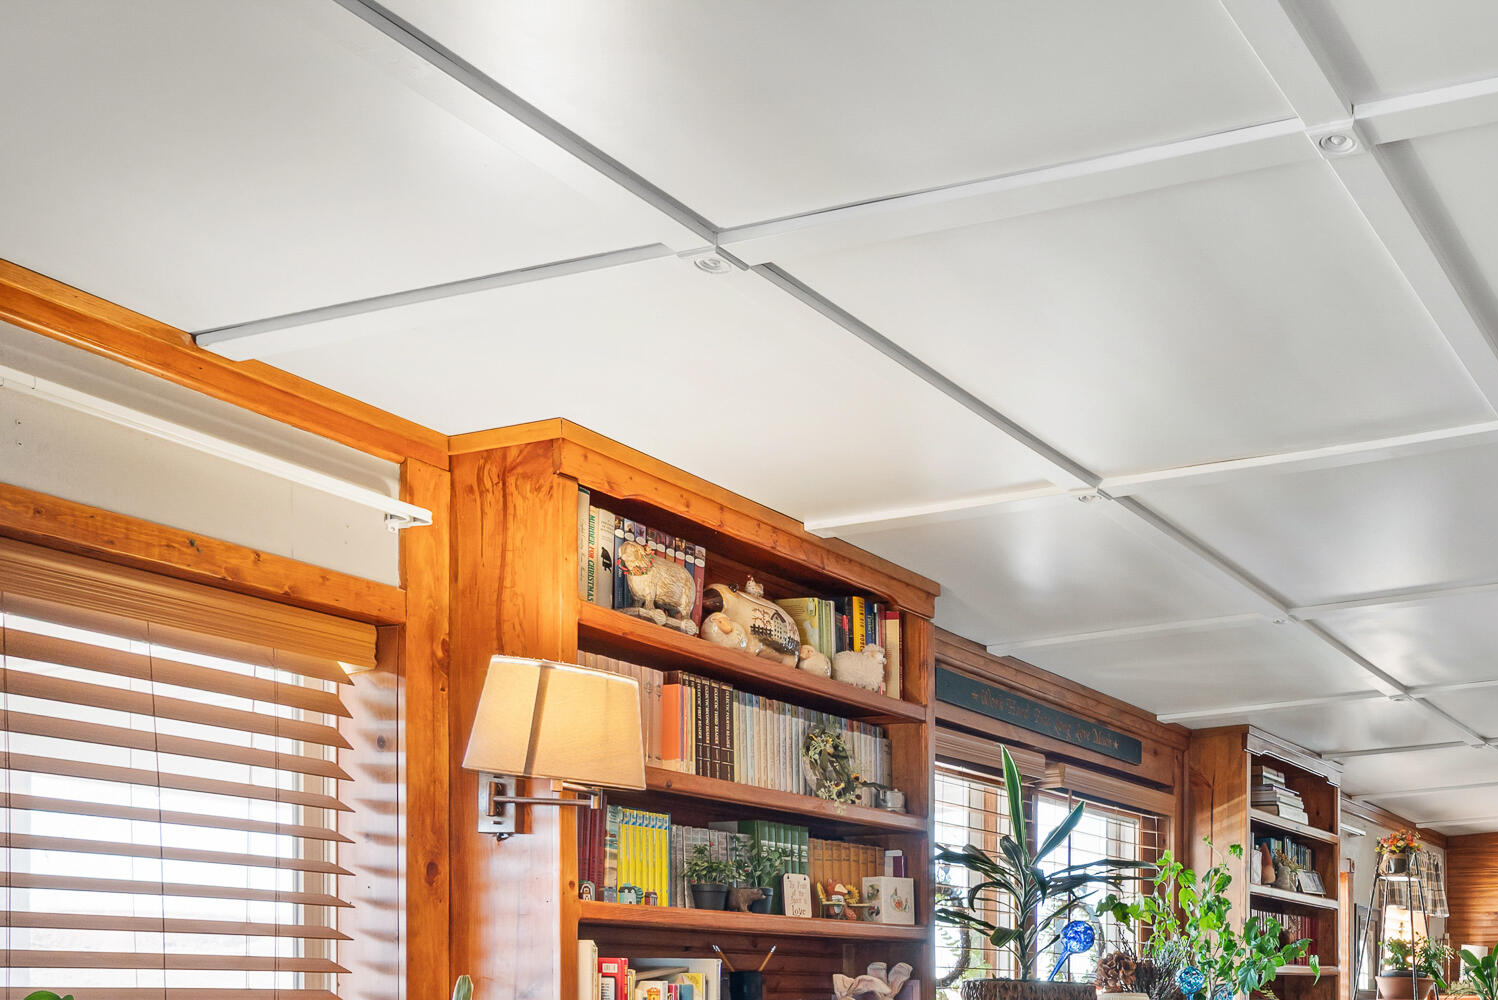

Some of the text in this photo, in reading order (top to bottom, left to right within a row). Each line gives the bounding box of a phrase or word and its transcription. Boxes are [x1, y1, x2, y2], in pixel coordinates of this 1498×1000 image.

[588, 515, 596, 545] MURDER
[587, 560, 595, 602] CHRISTMAS
[791, 904, 807, 916] love
